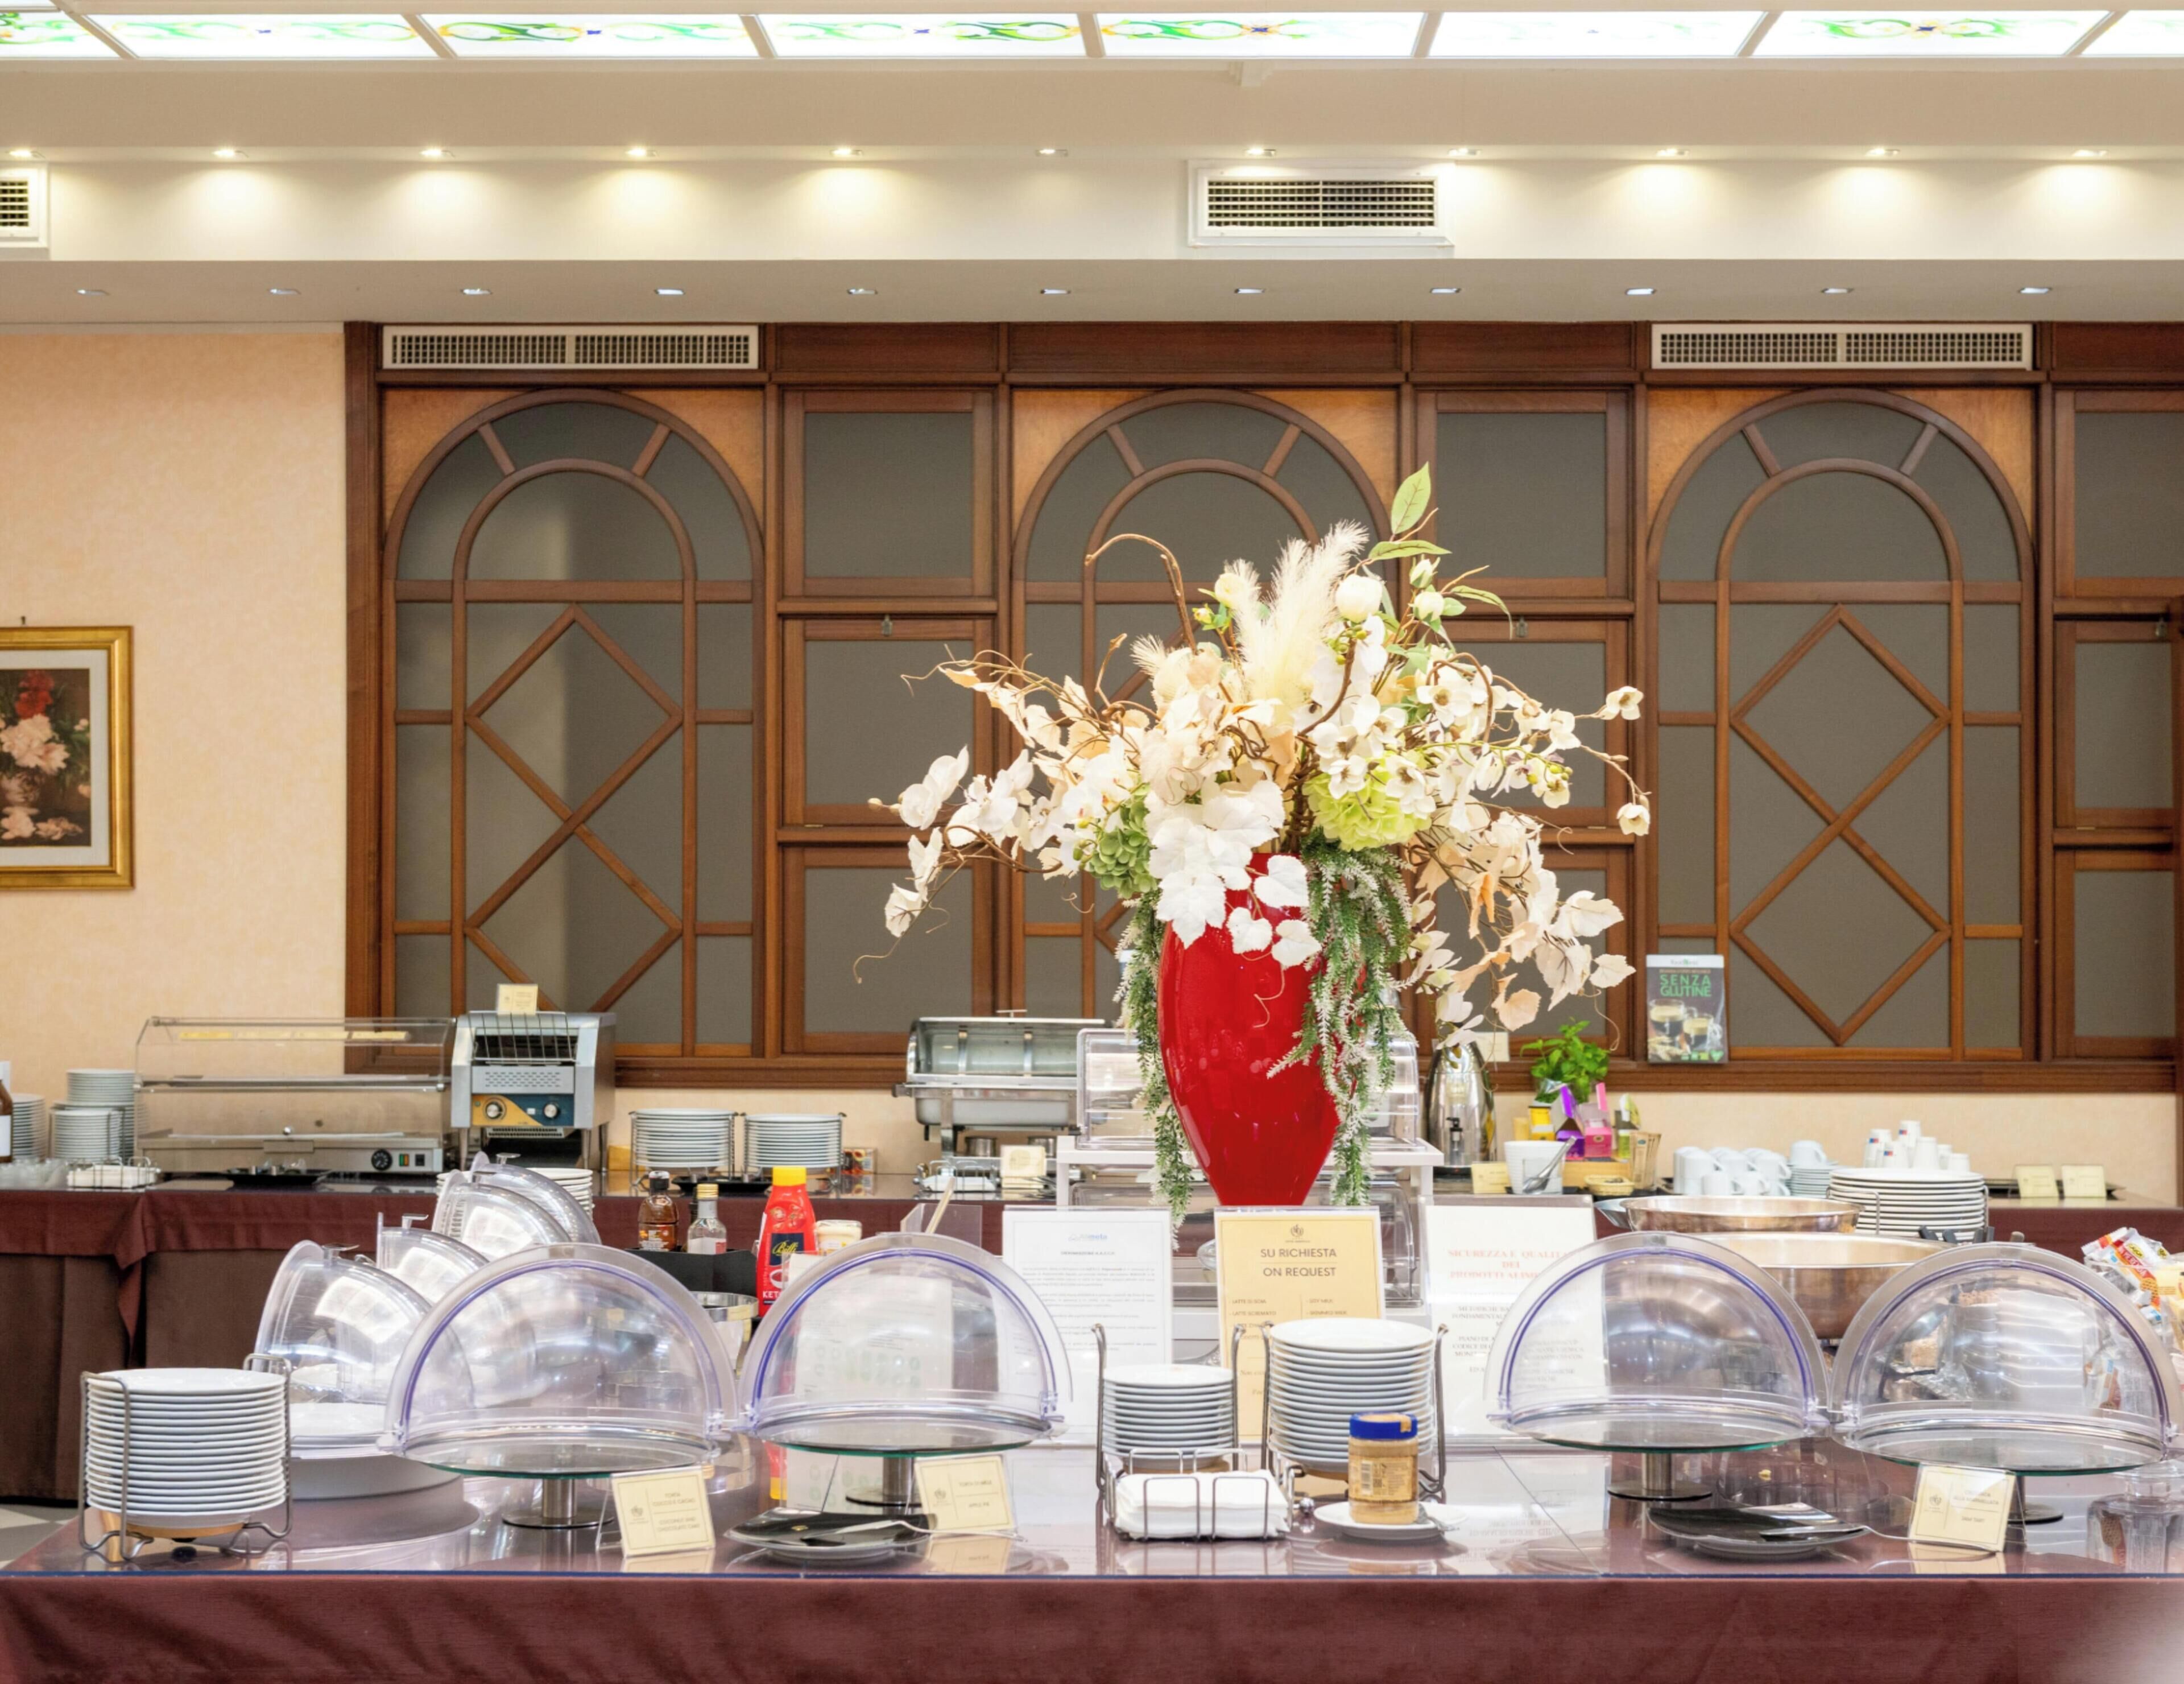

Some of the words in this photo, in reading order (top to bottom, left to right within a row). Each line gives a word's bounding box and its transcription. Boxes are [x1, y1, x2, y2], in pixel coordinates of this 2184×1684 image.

[1660, 974, 1711, 985] SENZA
[1660, 985, 1712, 997] GLUTINE
[1260, 1248, 1276, 1258] SU
[1279, 1248, 1337, 1258] RICHIESTA
[1263, 1267, 1282, 1277] ON
[1285, 1267, 1337, 1277] REQUEST
